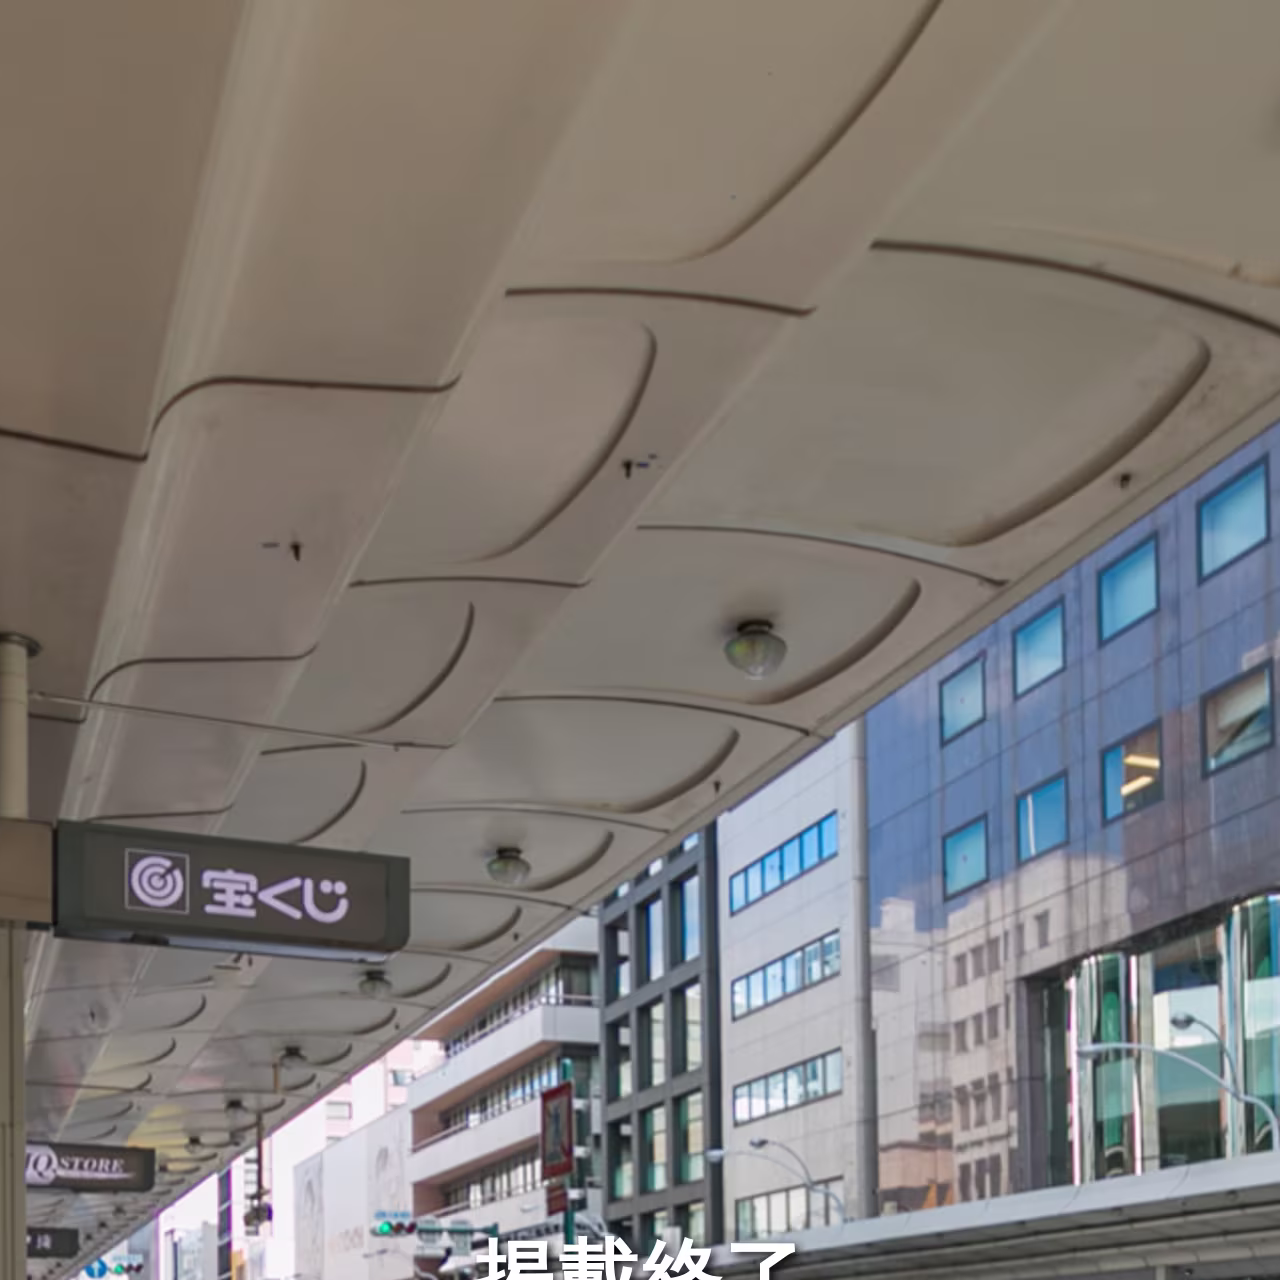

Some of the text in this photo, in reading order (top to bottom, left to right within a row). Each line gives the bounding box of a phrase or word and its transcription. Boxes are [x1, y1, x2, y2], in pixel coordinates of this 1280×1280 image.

[201, 868, 349, 924] 宝くじ
[59, 1155, 125, 1174] STORE
